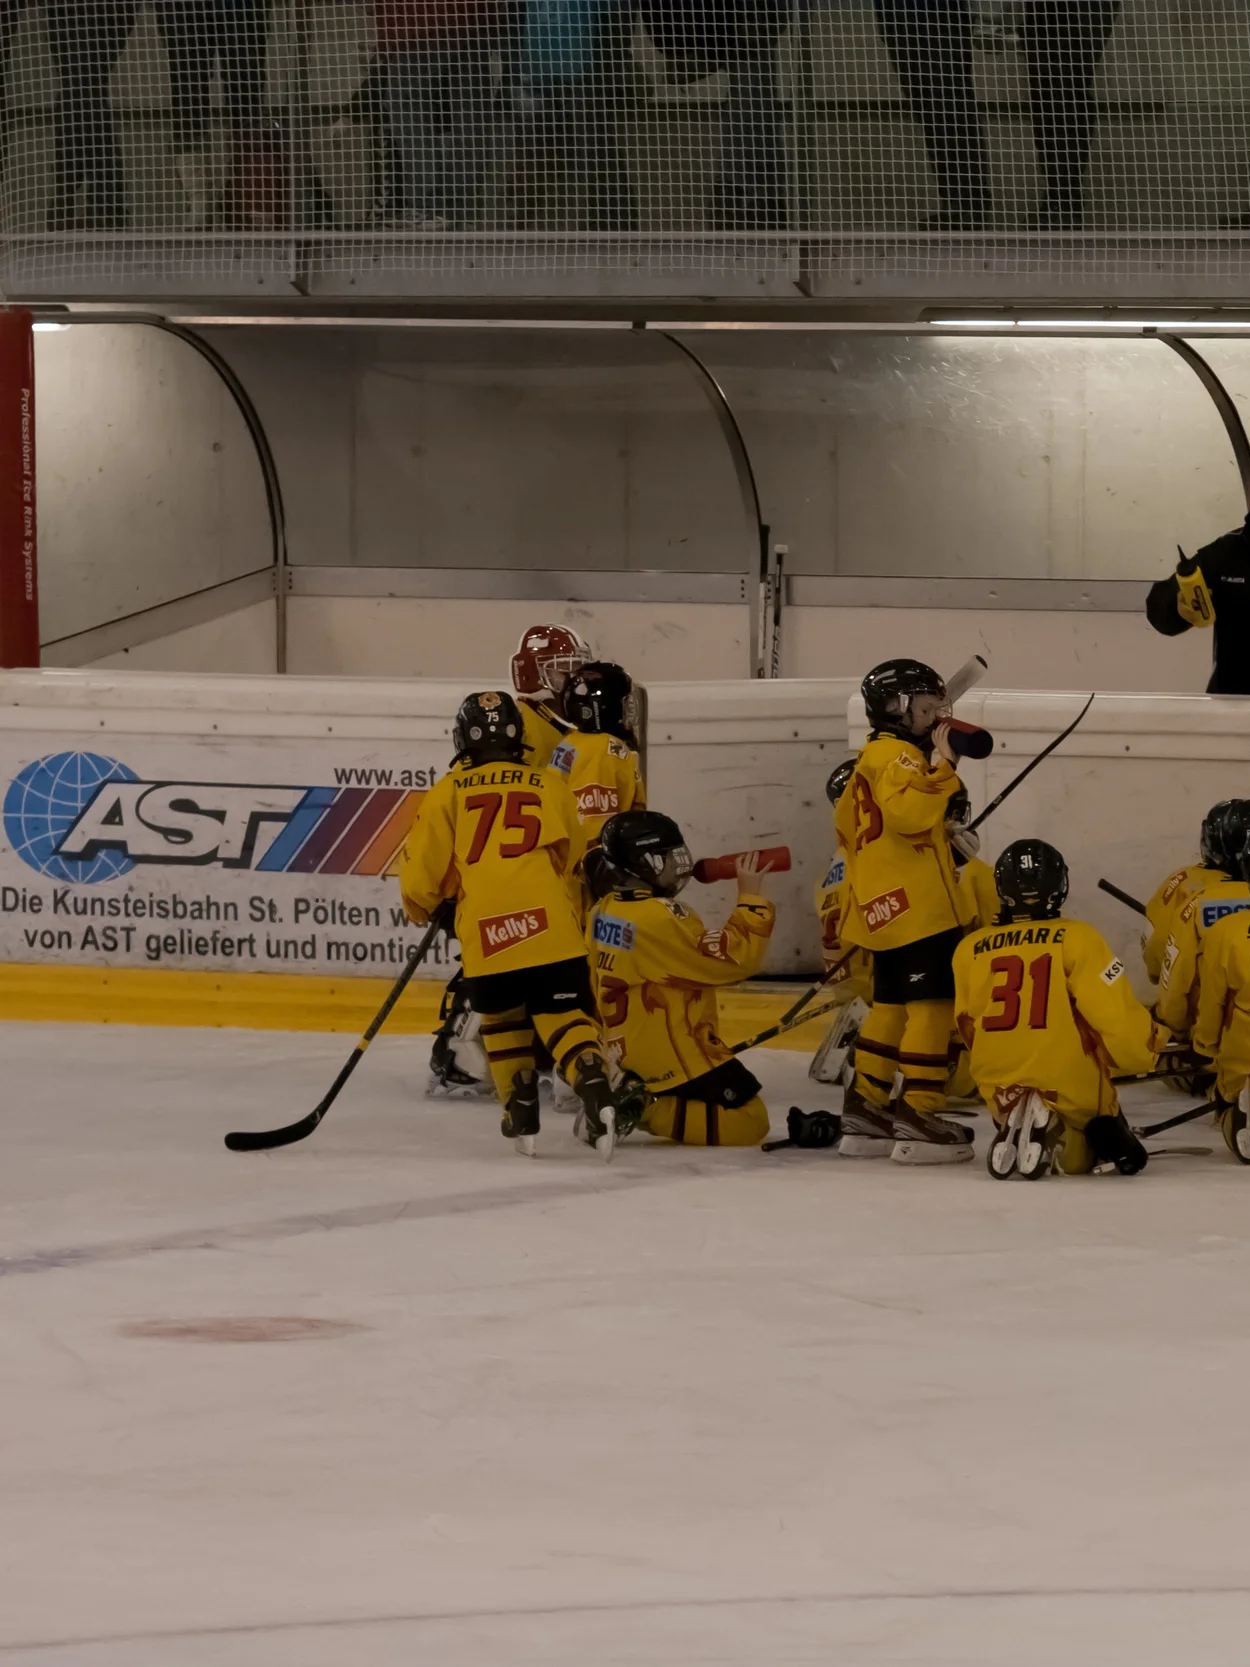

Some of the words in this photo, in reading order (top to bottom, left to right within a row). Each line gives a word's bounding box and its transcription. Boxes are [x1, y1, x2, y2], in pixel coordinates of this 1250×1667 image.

[21, 388, 31, 475] Professional
[22, 480, 32, 501] Ice
[23, 506, 32, 537] Rink
[23, 541, 33, 601] Systems
[486, 711, 499, 722] 75
[454, 770, 521, 788] MÜLLER
[529, 774, 545, 789] G.
[54, 781, 308, 869] AST
[464, 791, 541, 866] 75
[1020, 855, 1034, 869] 31
[1, 887, 43, 914] Die
[53, 889, 238, 921] Kunsteisbahn
[249, 896, 283, 923] St.
[294, 897, 380, 927] Pölten
[864, 896, 901, 926] elly's
[24, 929, 72, 950] von
[80, 927, 136, 952] AST
[146, 930, 257, 960] geliefert
[265, 935, 318, 959] und
[486, 913, 539, 946] Kelly's
[982, 953, 1053, 1032] 31
